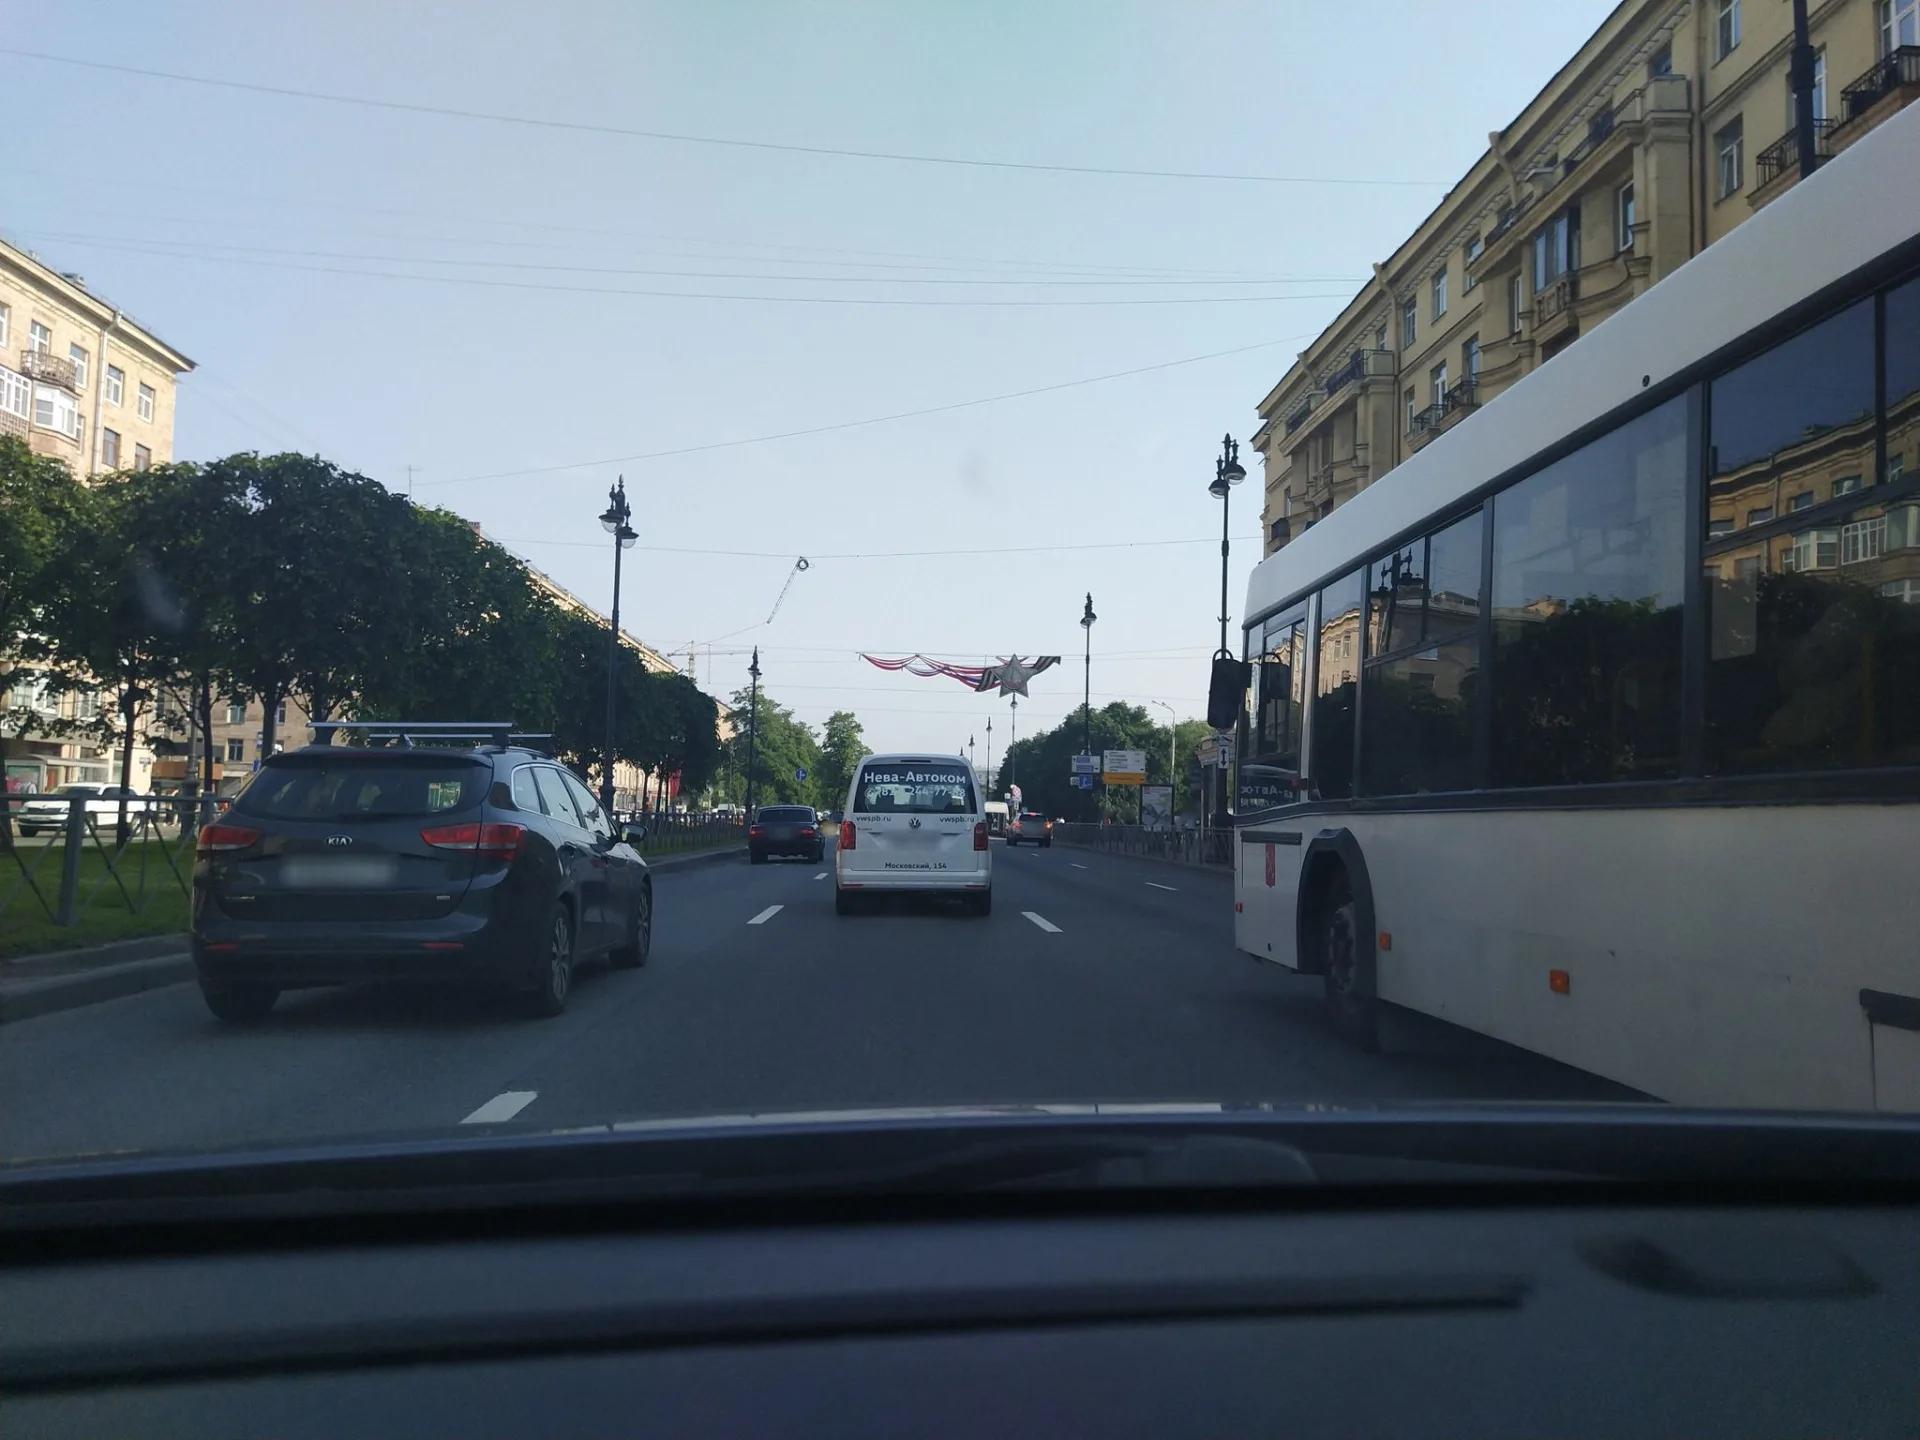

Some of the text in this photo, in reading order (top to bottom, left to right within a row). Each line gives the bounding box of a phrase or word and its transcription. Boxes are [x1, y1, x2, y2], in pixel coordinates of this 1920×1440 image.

[864, 771, 966, 784] Нева-Автоком
[856, 815, 891, 823] vwspb.ru
[327, 836, 348, 846] KIA
[885, 862, 931, 870] Московский,
